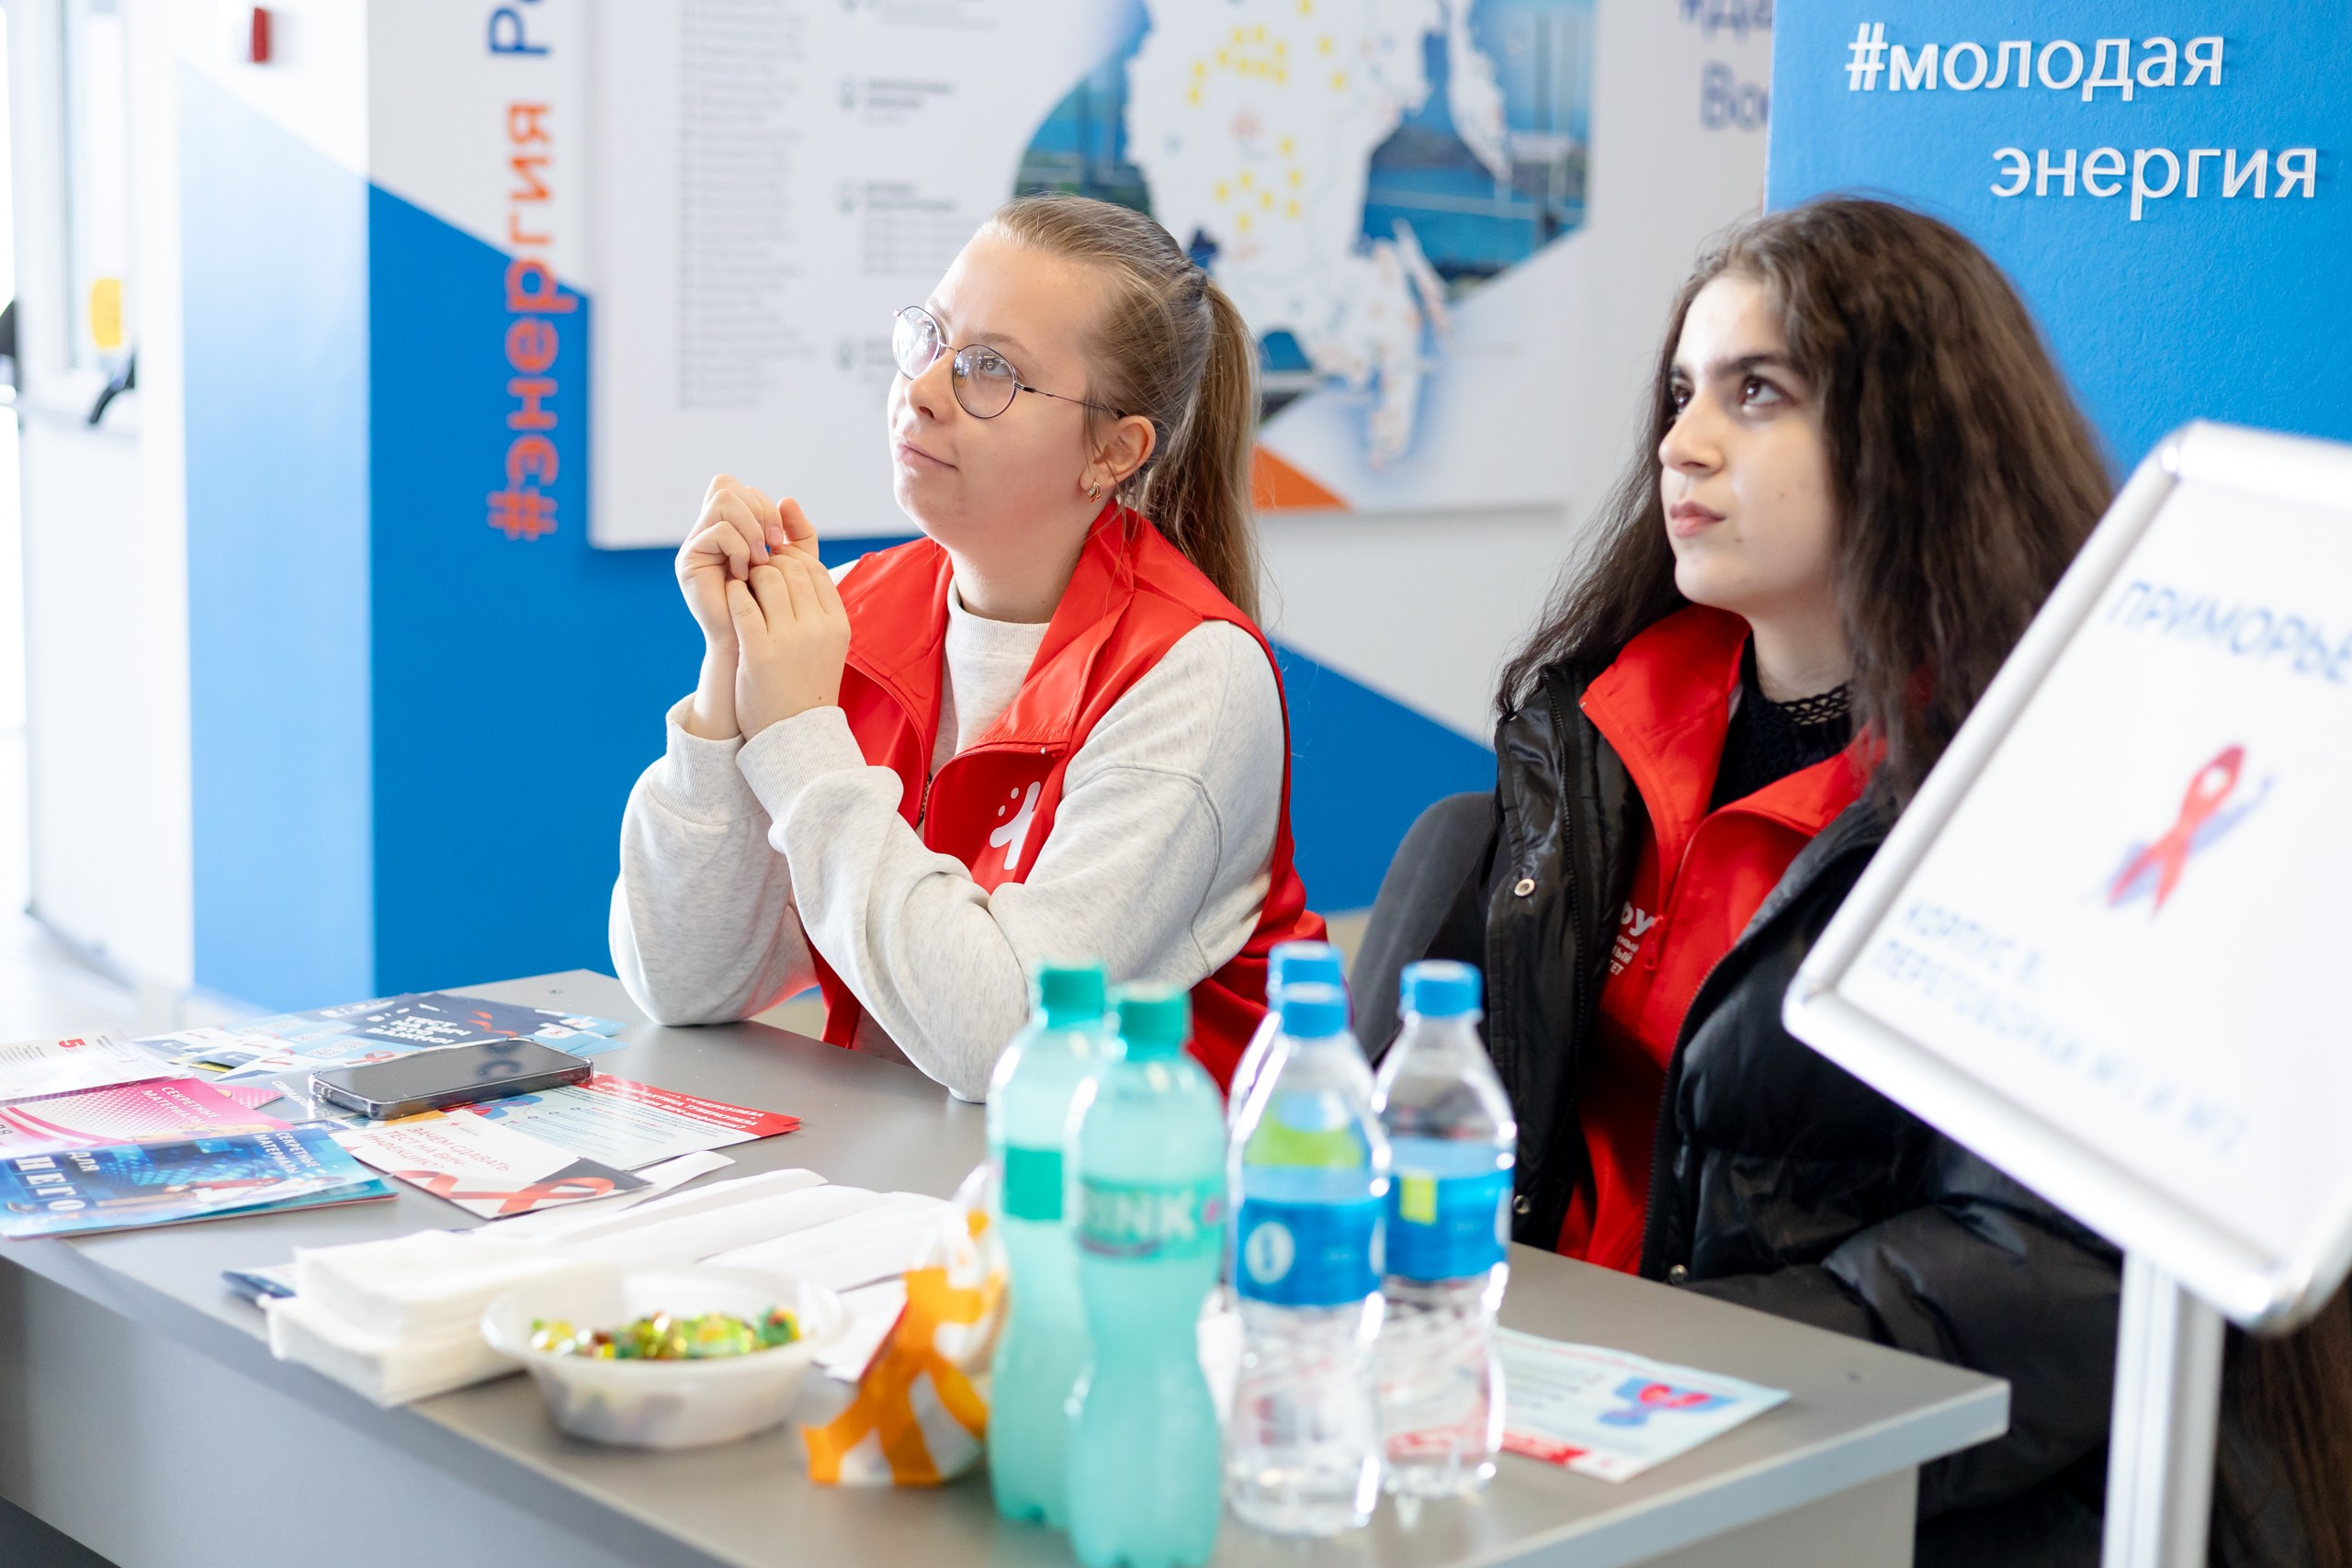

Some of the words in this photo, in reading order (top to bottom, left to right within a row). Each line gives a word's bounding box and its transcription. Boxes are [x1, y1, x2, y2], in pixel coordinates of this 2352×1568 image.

[488, 0, 553, 57] Р
[1845, 22, 2226, 102] #молодая
[1990, 146, 2318, 221] энергия
[487, 101, 577, 542] #энергия
[65, 1152, 100, 1172] ДЛЯ
[253, 1134, 301, 1174] МАТЕРИАЛЫ
[276, 1132, 321, 1168] СЕКРЕТНЫЕ
[384, 1131, 420, 1147] ТЕСТ
[417, 1144, 434, 1154] НА
[407, 1126, 452, 1147] ЗАЧЕМ
[450, 1145, 512, 1172] СДАВАТЬ
[15, 1156, 86, 1211] НЕГО
